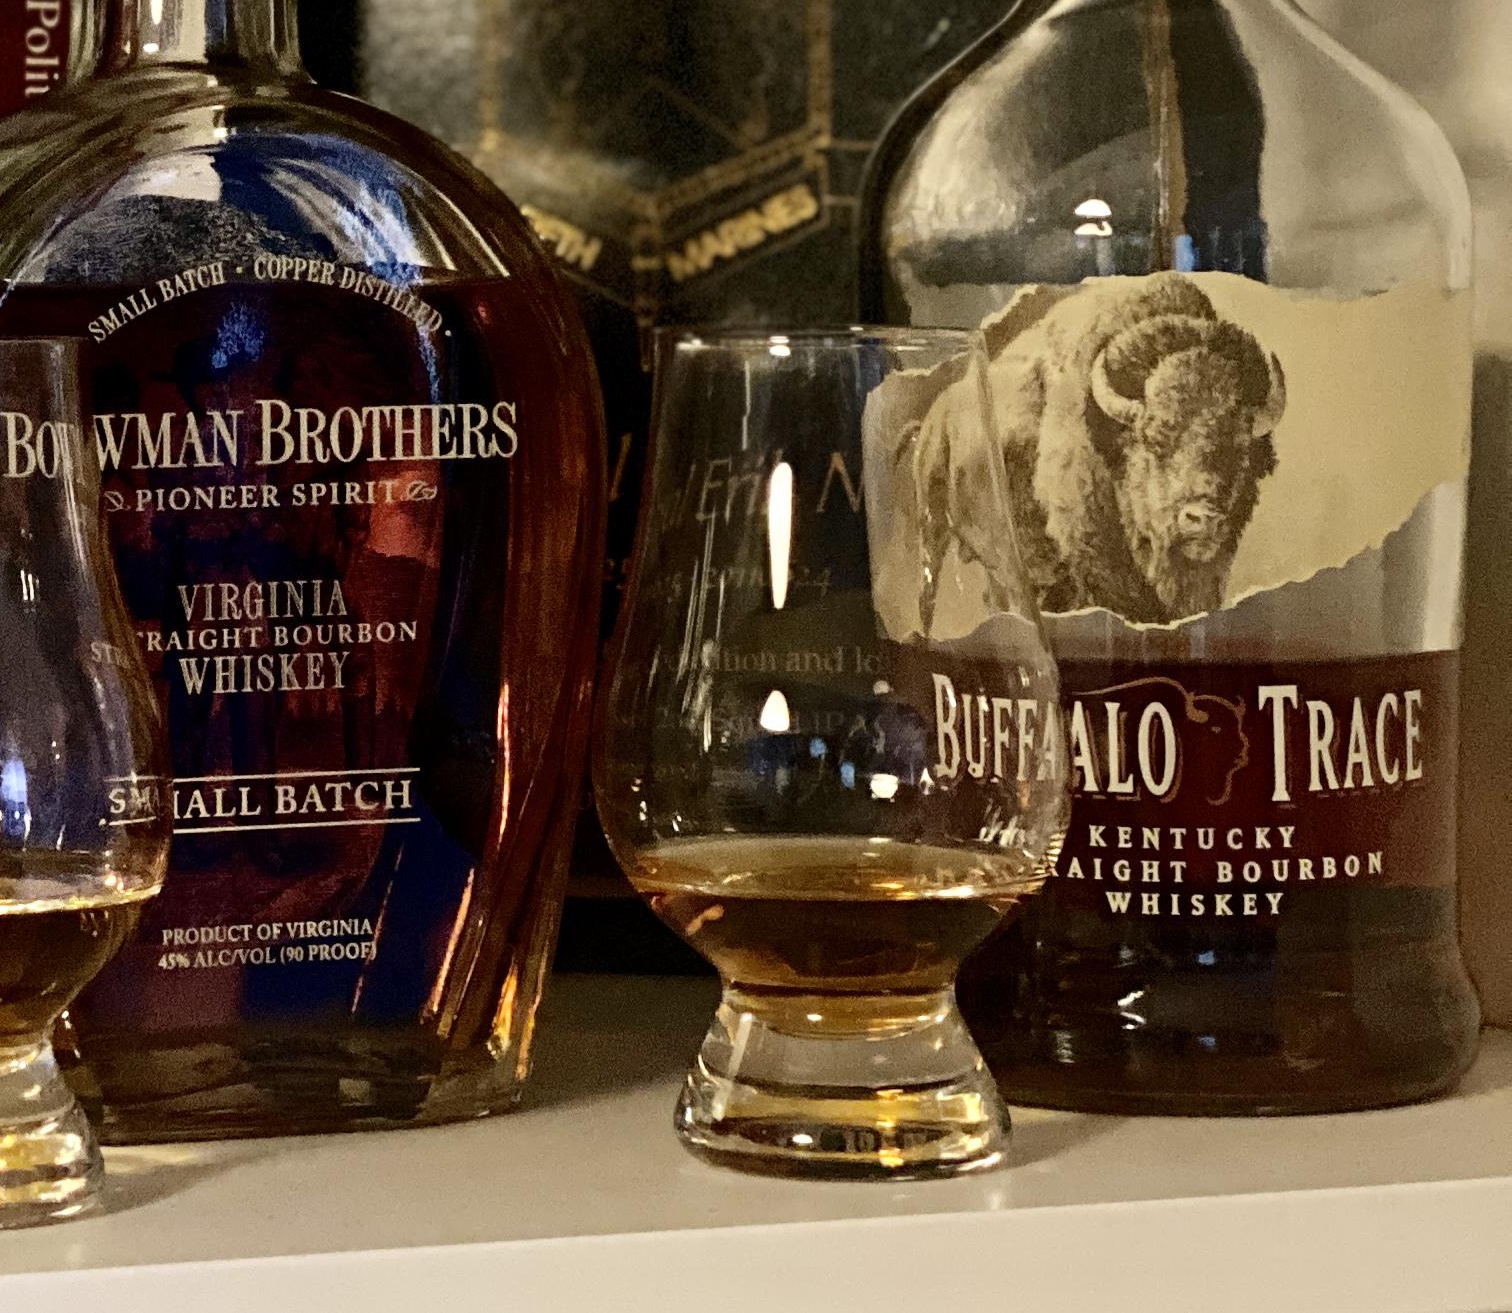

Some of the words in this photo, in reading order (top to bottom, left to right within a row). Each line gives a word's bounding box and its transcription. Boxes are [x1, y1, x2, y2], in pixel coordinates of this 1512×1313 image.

[88, 289, 157, 343] SMALL
[155, 261, 225, 304] BATCH
[253, 253, 337, 287] COPPER
[338, 265, 444, 334] DISTILLED
[254, 397, 519, 467] BROTHERS
[135, 484, 282, 513] PIONEER
[291, 479, 404, 508] SPIRIT
[177, 579, 348, 622] VIRGINIA
[274, 621, 418, 648] BOURBON
[178, 651, 351, 696] WHISKEY
[932, 672, 1177, 797] BUFFALO
[1258, 685, 1425, 803] TRACE
[275, 778, 413, 815] BATCH
[1088, 823, 1296, 851] KENTUCKY
[1216, 850, 1385, 884] BOURBON
[1105, 891, 1285, 916] WHISKEY
[162, 924, 253, 946] PRODUCT
[256, 922, 284, 941] OF
[286, 918, 373, 939] VIRGINIA
[158, 952, 190, 970] 45%
[192, 946, 277, 969] ALC/VOL
[280, 944, 305, 966] (90
[307, 940, 377, 962] PROOF)
